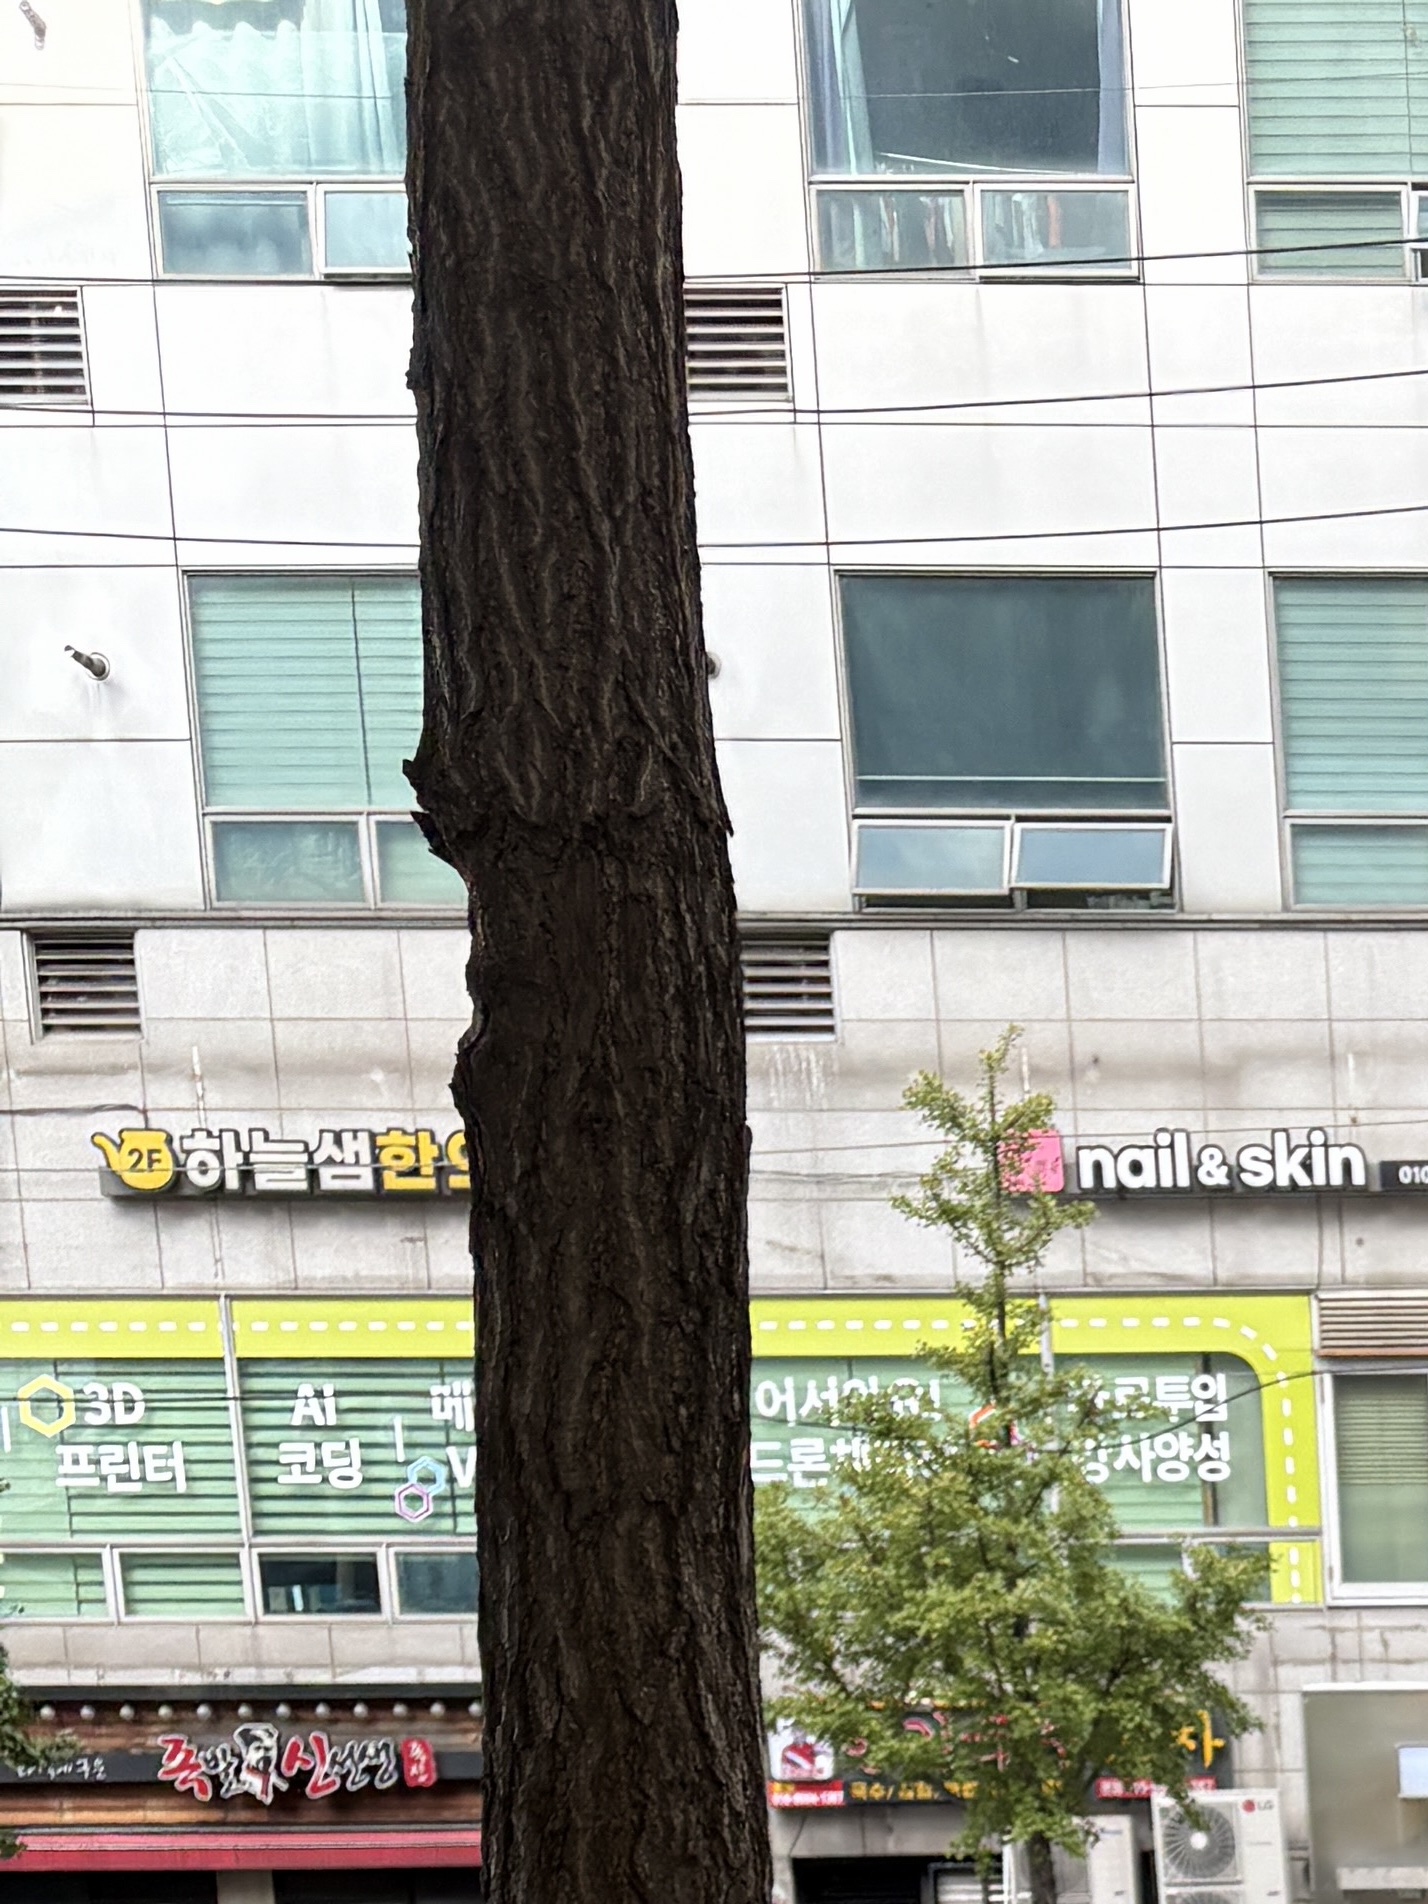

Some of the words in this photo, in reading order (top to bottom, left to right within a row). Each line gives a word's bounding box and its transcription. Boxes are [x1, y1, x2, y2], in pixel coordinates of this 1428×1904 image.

[1077, 1128, 1190, 1188] nail
[1197, 1145, 1231, 1188] &
[1239, 1128, 1366, 1188] skin
[83, 1382, 146, 1425] 3D
[55, 1440, 188, 1493] 프린터
[276, 1437, 364, 1489] 코딩
